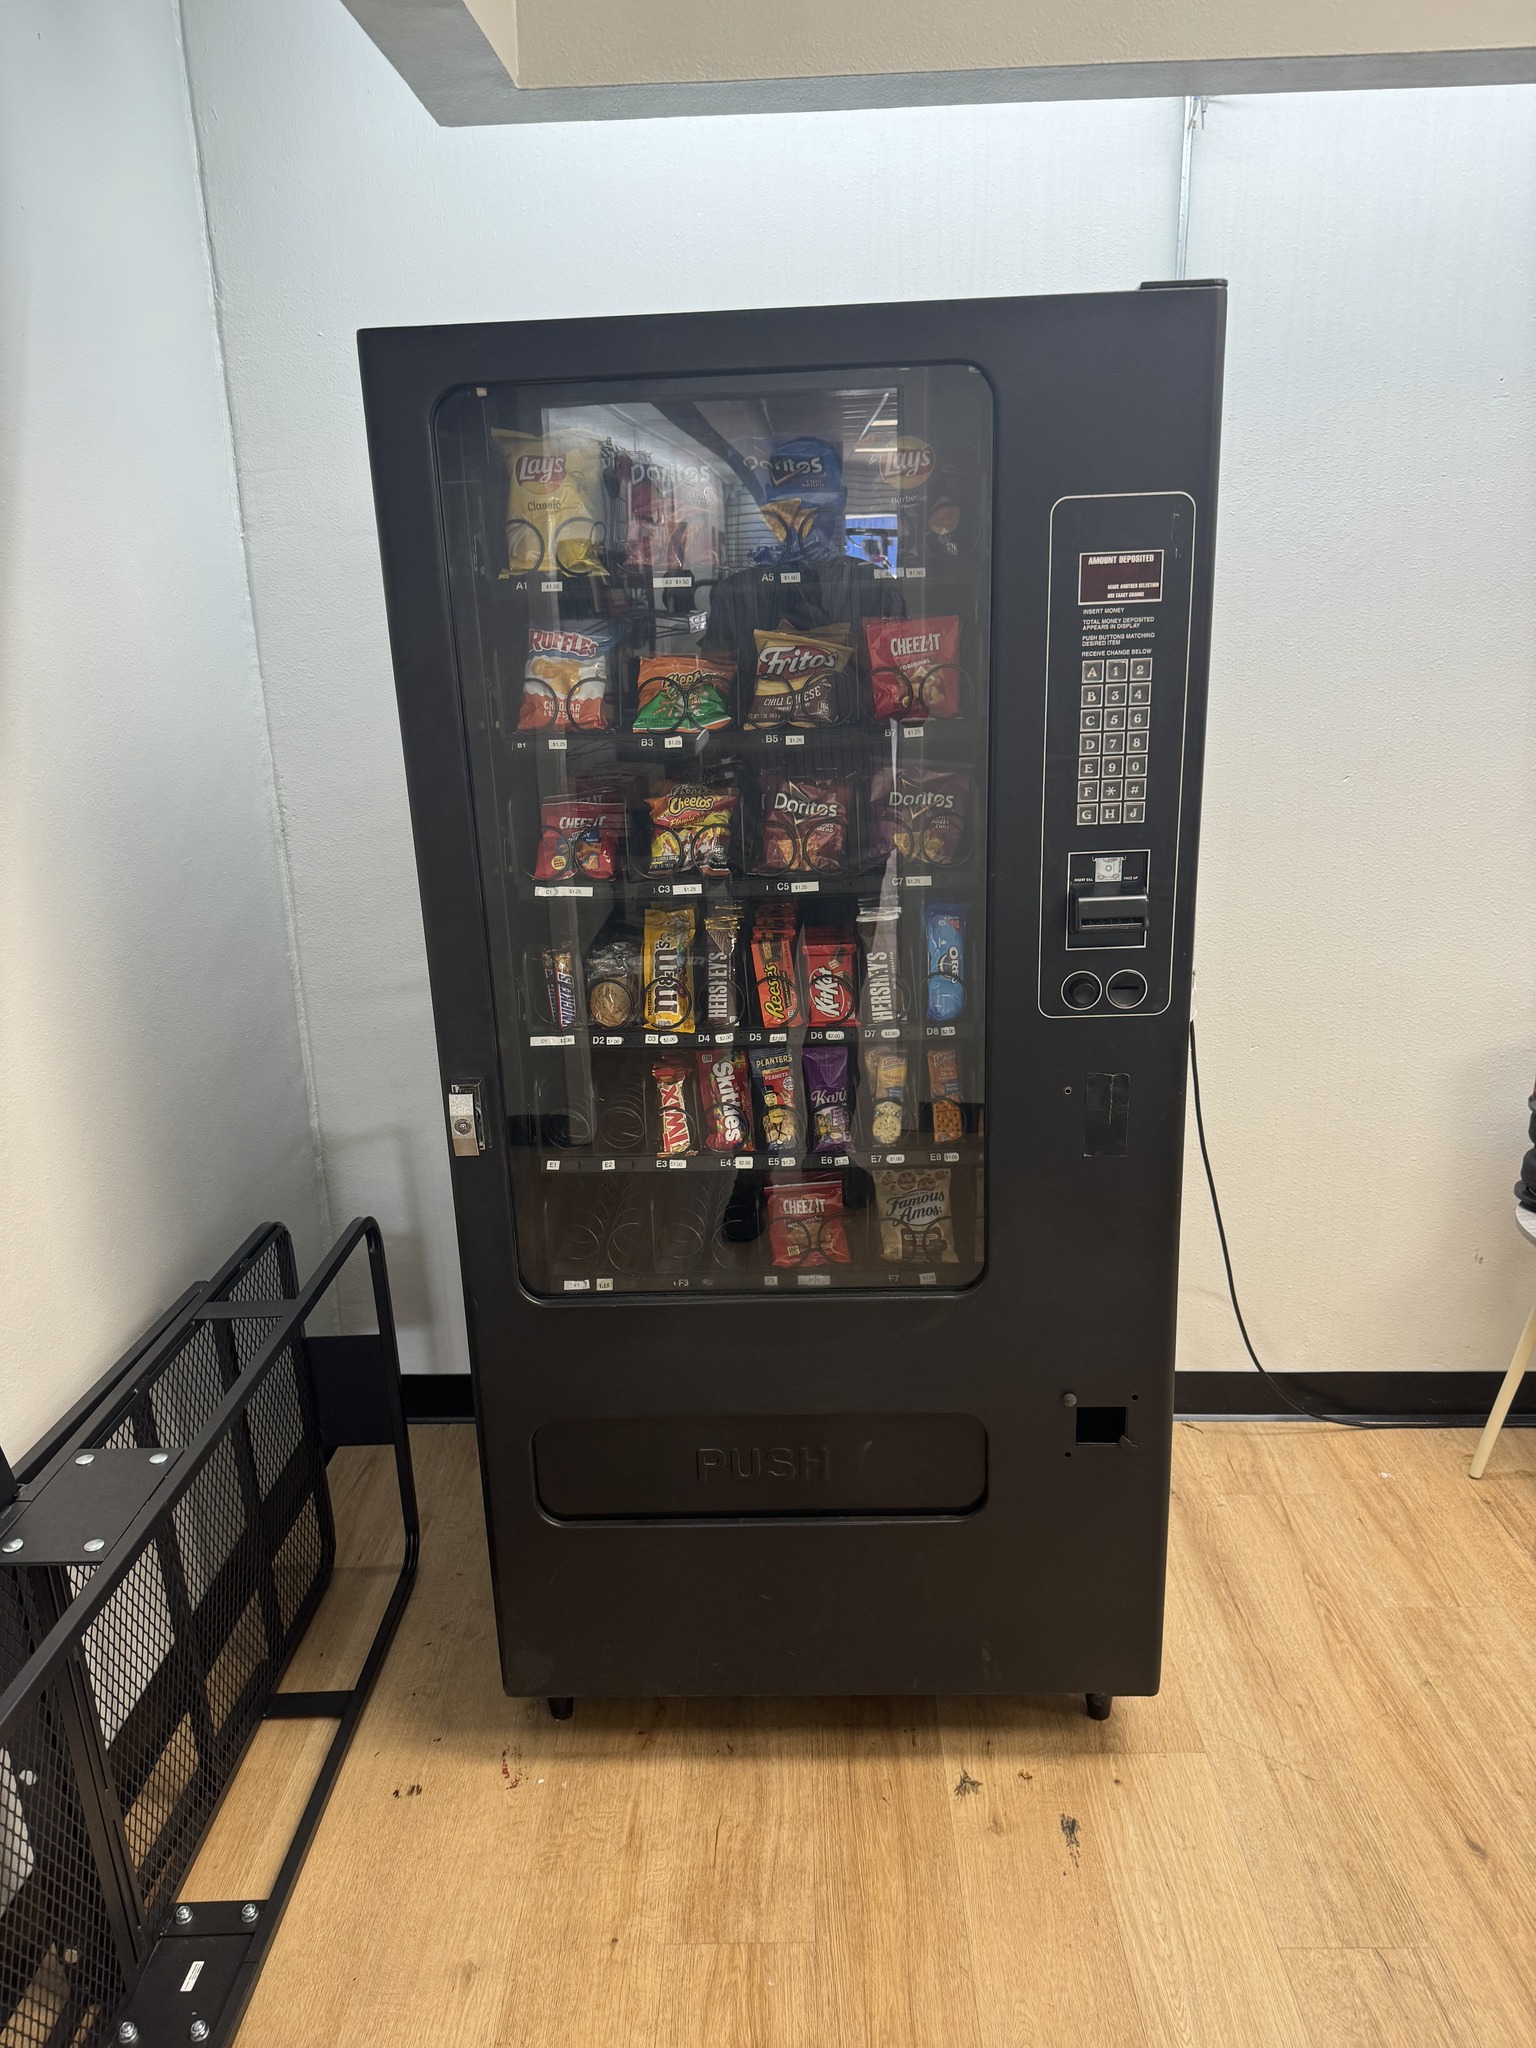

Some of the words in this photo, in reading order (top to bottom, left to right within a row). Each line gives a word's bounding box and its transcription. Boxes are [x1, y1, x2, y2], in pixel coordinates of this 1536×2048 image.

[743, 455, 823, 475] Doritos
[884, 448, 931, 479] Lay's
[519, 455, 566, 483] Lay's
[631, 463, 711, 486] Doritos
[891, 494, 928, 504] Barbecue
[527, 500, 561, 513] Classic
[1088, 556, 1118, 566] AMOUNT
[1118, 554, 1155, 564] DEPOSITED
[761, 573, 775, 582] A5
[515, 582, 528, 590] A1
[1083, 618, 1101, 626] TOTAL
[530, 630, 599, 658] RUFFLES
[1081, 650, 1107, 658] RECEIVE
[760, 646, 838, 674] Fritos
[902, 658, 931, 671] ORIGINAL
[1086, 667, 1097, 678] A
[1113, 666, 1118, 676] 1
[1136, 665, 1144, 675] 2
[1086, 691, 1096, 702] B
[1111, 690, 1120, 700] 3
[1134, 689, 1142, 700] 4
[763, 697, 783, 706] CHILI
[1085, 716, 1095, 726] C
[1110, 714, 1118, 724] 5
[1134, 714, 1142, 724] 6
[641, 738, 654, 747] B3
[765, 734, 778, 743] B5
[1085, 739, 1095, 750] D
[1109, 738, 1117, 749] 7
[1132, 738, 1140, 748] 8
[1084, 763, 1094, 774] E
[1108, 763, 1116, 772] 9
[1132, 761, 1139, 771] 0
[1083, 786, 1094, 797] F
[774, 792, 839, 817] Doritos
[889, 791, 955, 809] Doritos
[669, 796, 714, 815] Cheetos
[1082, 810, 1092, 820] G
[1104, 809, 1115, 819] H
[1130, 808, 1137, 818] J
[776, 882, 790, 891] C5
[891, 877, 904, 887] C7
[657, 885, 671, 894] C3
[764, 962, 785, 1019] Reese's
[749, 1032, 762, 1041] D5
[810, 1031, 823, 1039] D6
[864, 1029, 876, 1038] D7
[926, 1027, 939, 1036] D8
[592, 1036, 605, 1045] D2
[698, 1034, 711, 1043] D4
[756, 1054, 793, 1069] PLANTERS
[764, 1072, 789, 1081] PEANUTS
[712, 1061, 741, 1143] Skittles
[661, 1085, 689, 1153] TWIX
[768, 1157, 780, 1166] E5
[821, 1156, 833, 1165] E6
[870, 1155, 883, 1163] E7
[930, 1152, 942, 1161] E8
[656, 1159, 668, 1168] E3
[720, 1158, 731, 1167] E4
[886, 1190, 945, 1217] Famous
[892, 1207, 939, 1227] Amos
[678, 1279, 689, 1287] F3
[888, 1275, 900, 1284] F7
[697, 1447, 832, 1483] PUSH
